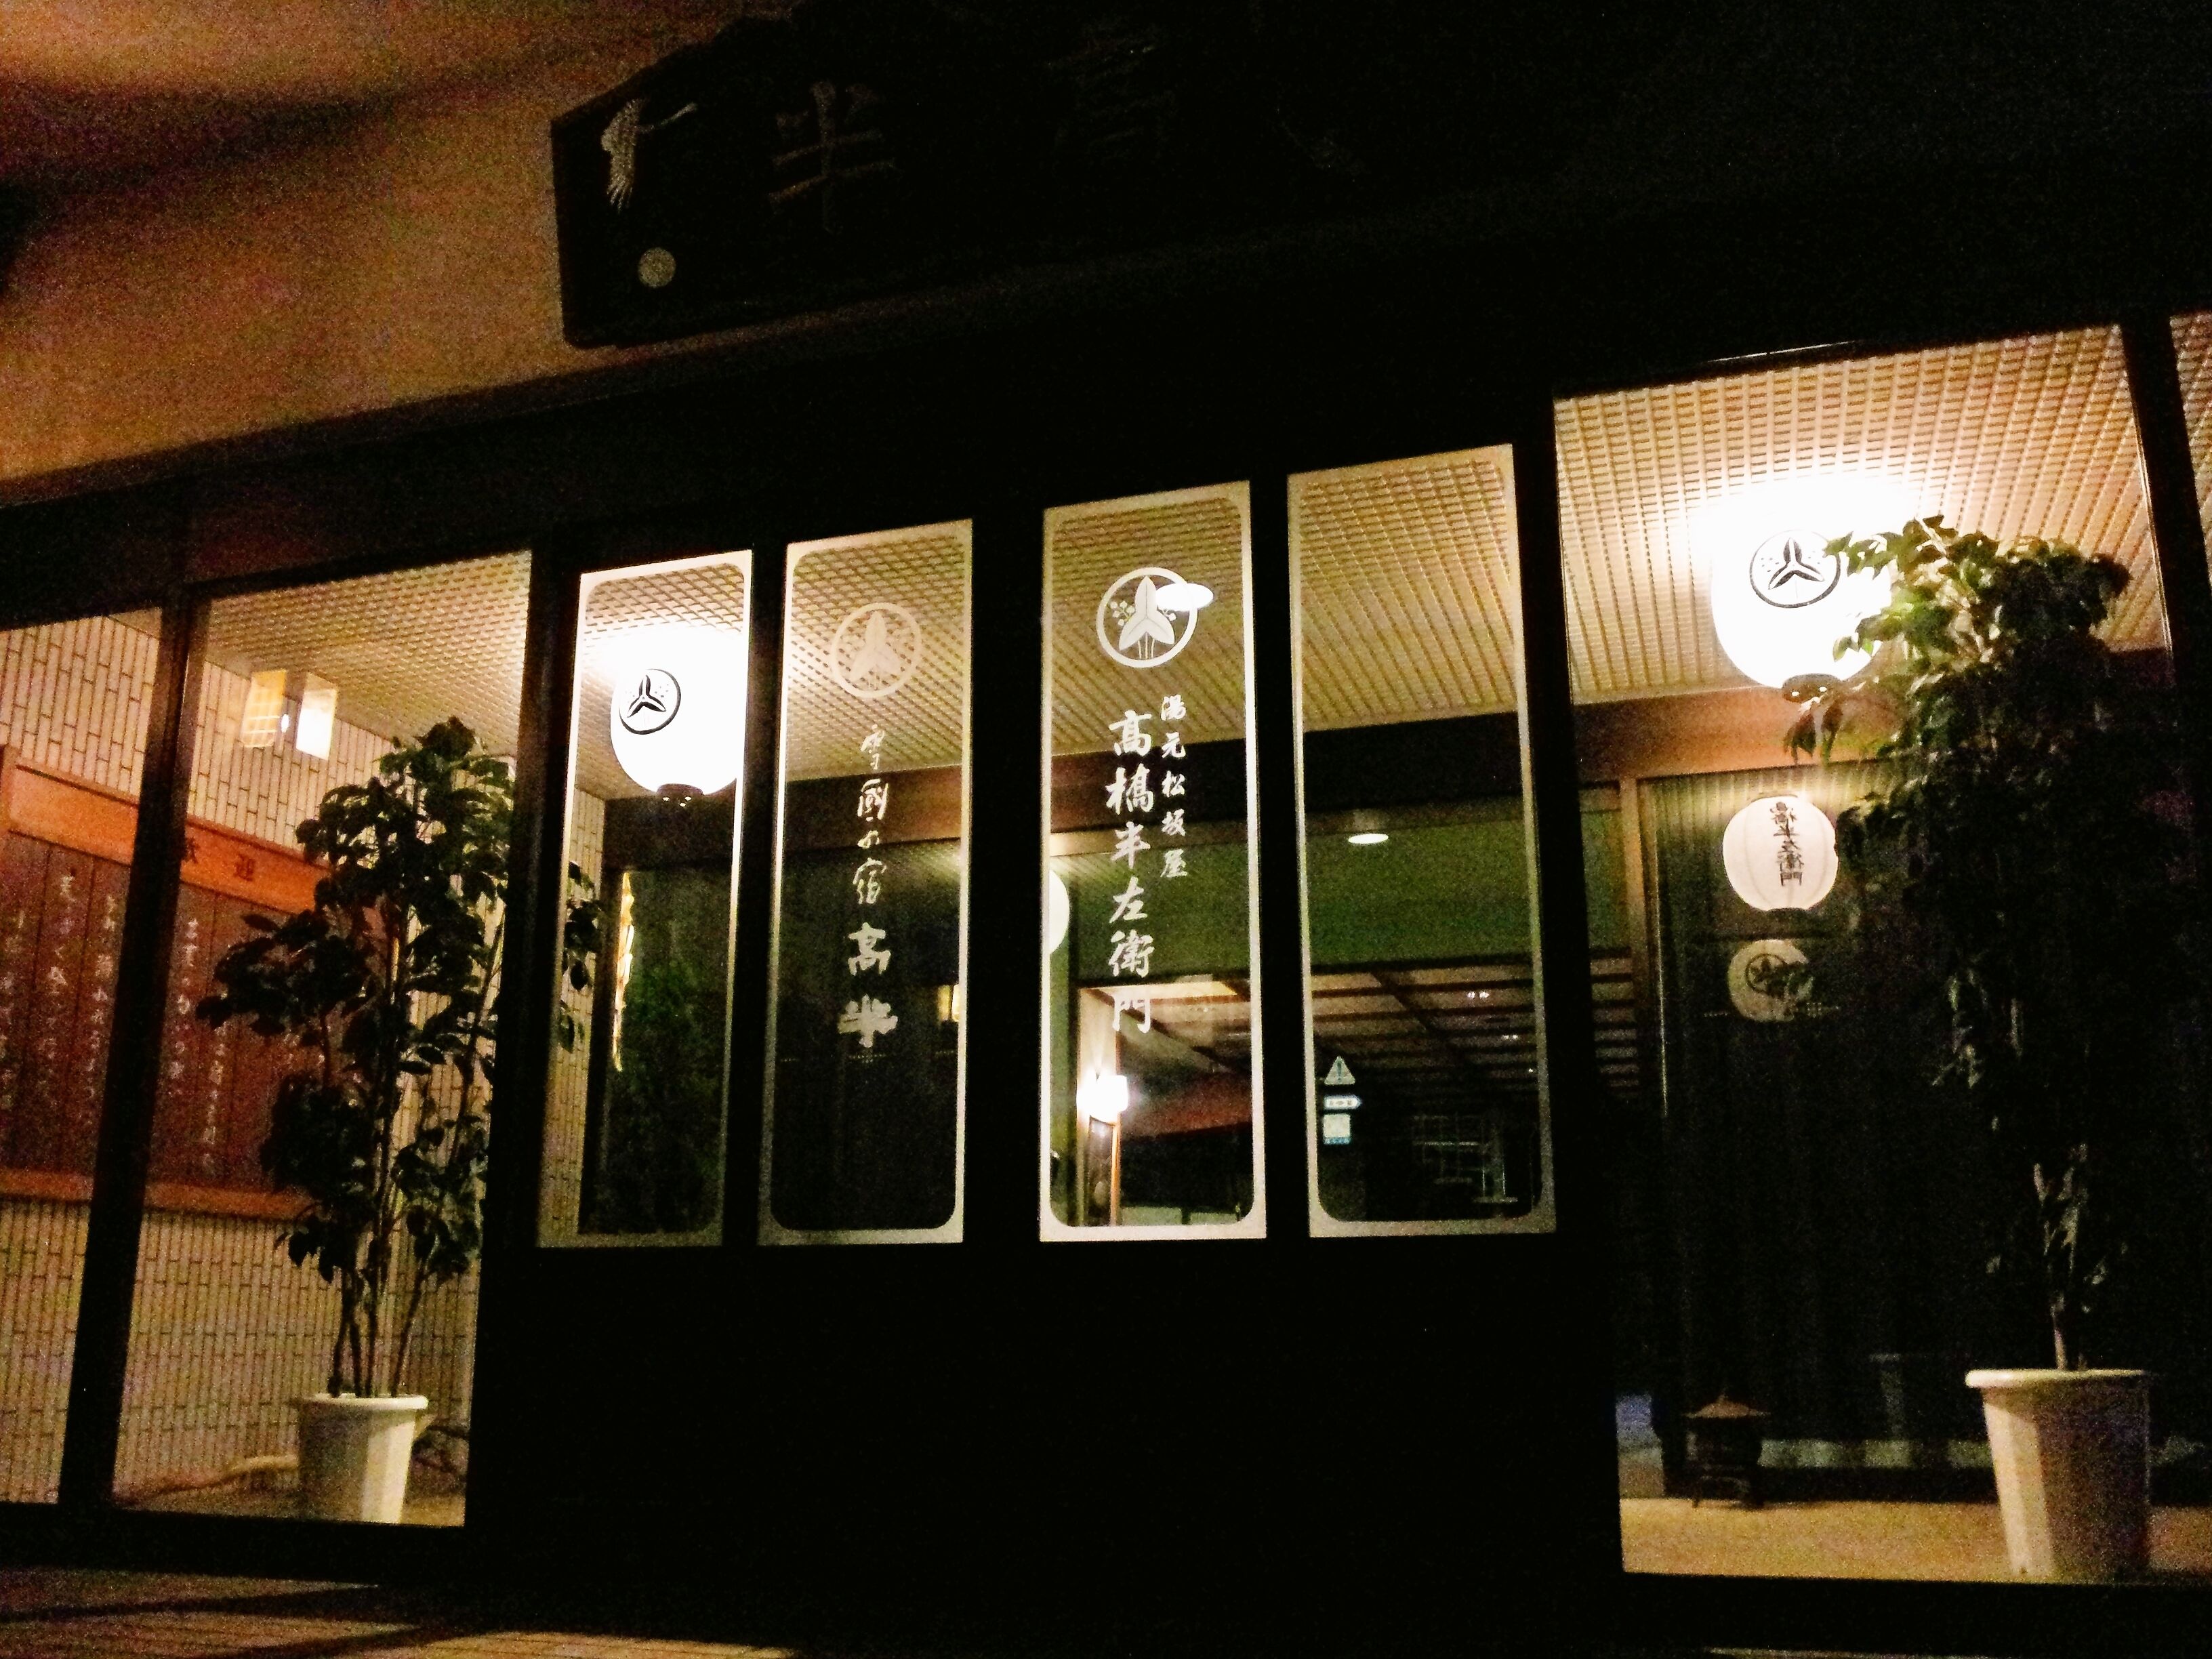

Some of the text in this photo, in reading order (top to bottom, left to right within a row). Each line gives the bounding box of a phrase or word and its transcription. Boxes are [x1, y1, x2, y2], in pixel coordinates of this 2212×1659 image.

[1105, 709, 1155, 1033] 高橋半左衛門
